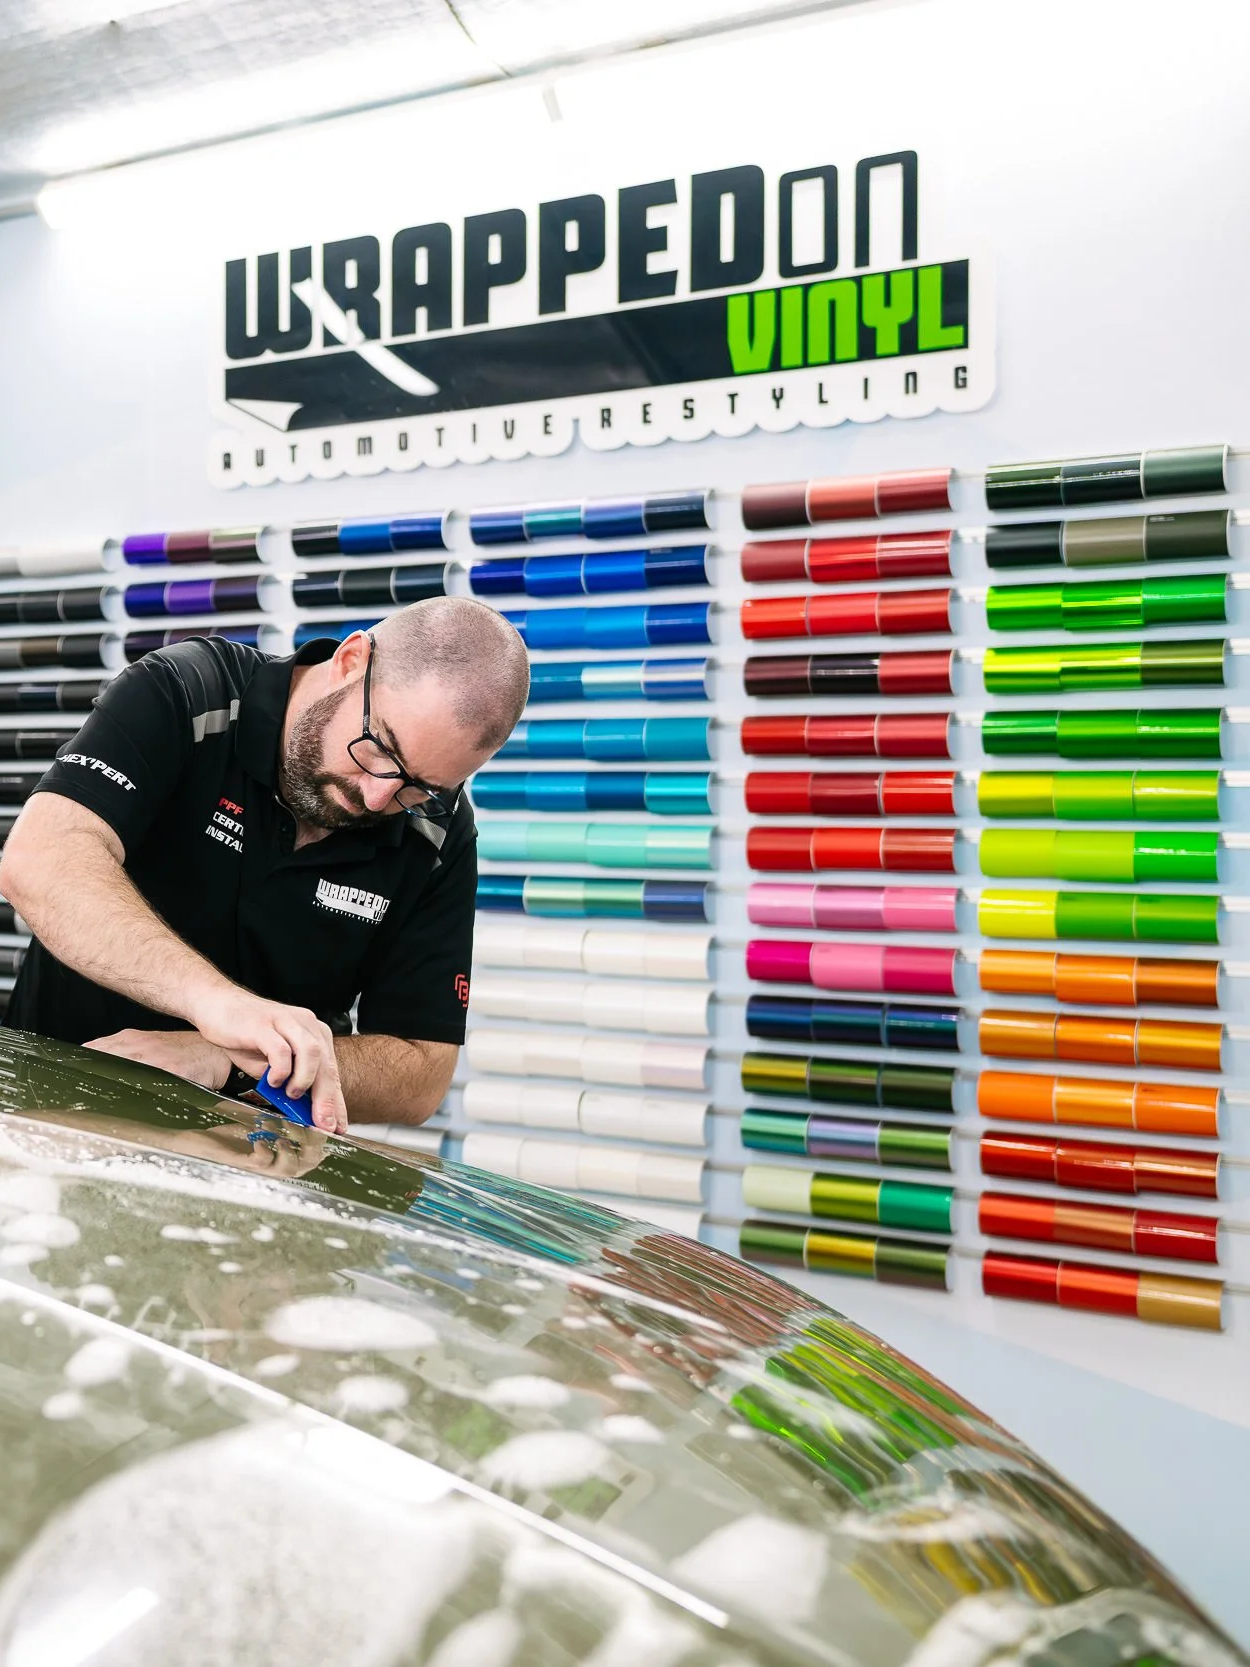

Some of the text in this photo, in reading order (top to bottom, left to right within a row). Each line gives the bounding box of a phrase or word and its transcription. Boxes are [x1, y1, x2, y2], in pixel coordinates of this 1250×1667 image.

[726, 264, 965, 376] VINYL
[222, 365, 969, 471] AUTOMOTIVE RESTYLING
[218, 796, 245, 815] PPF
